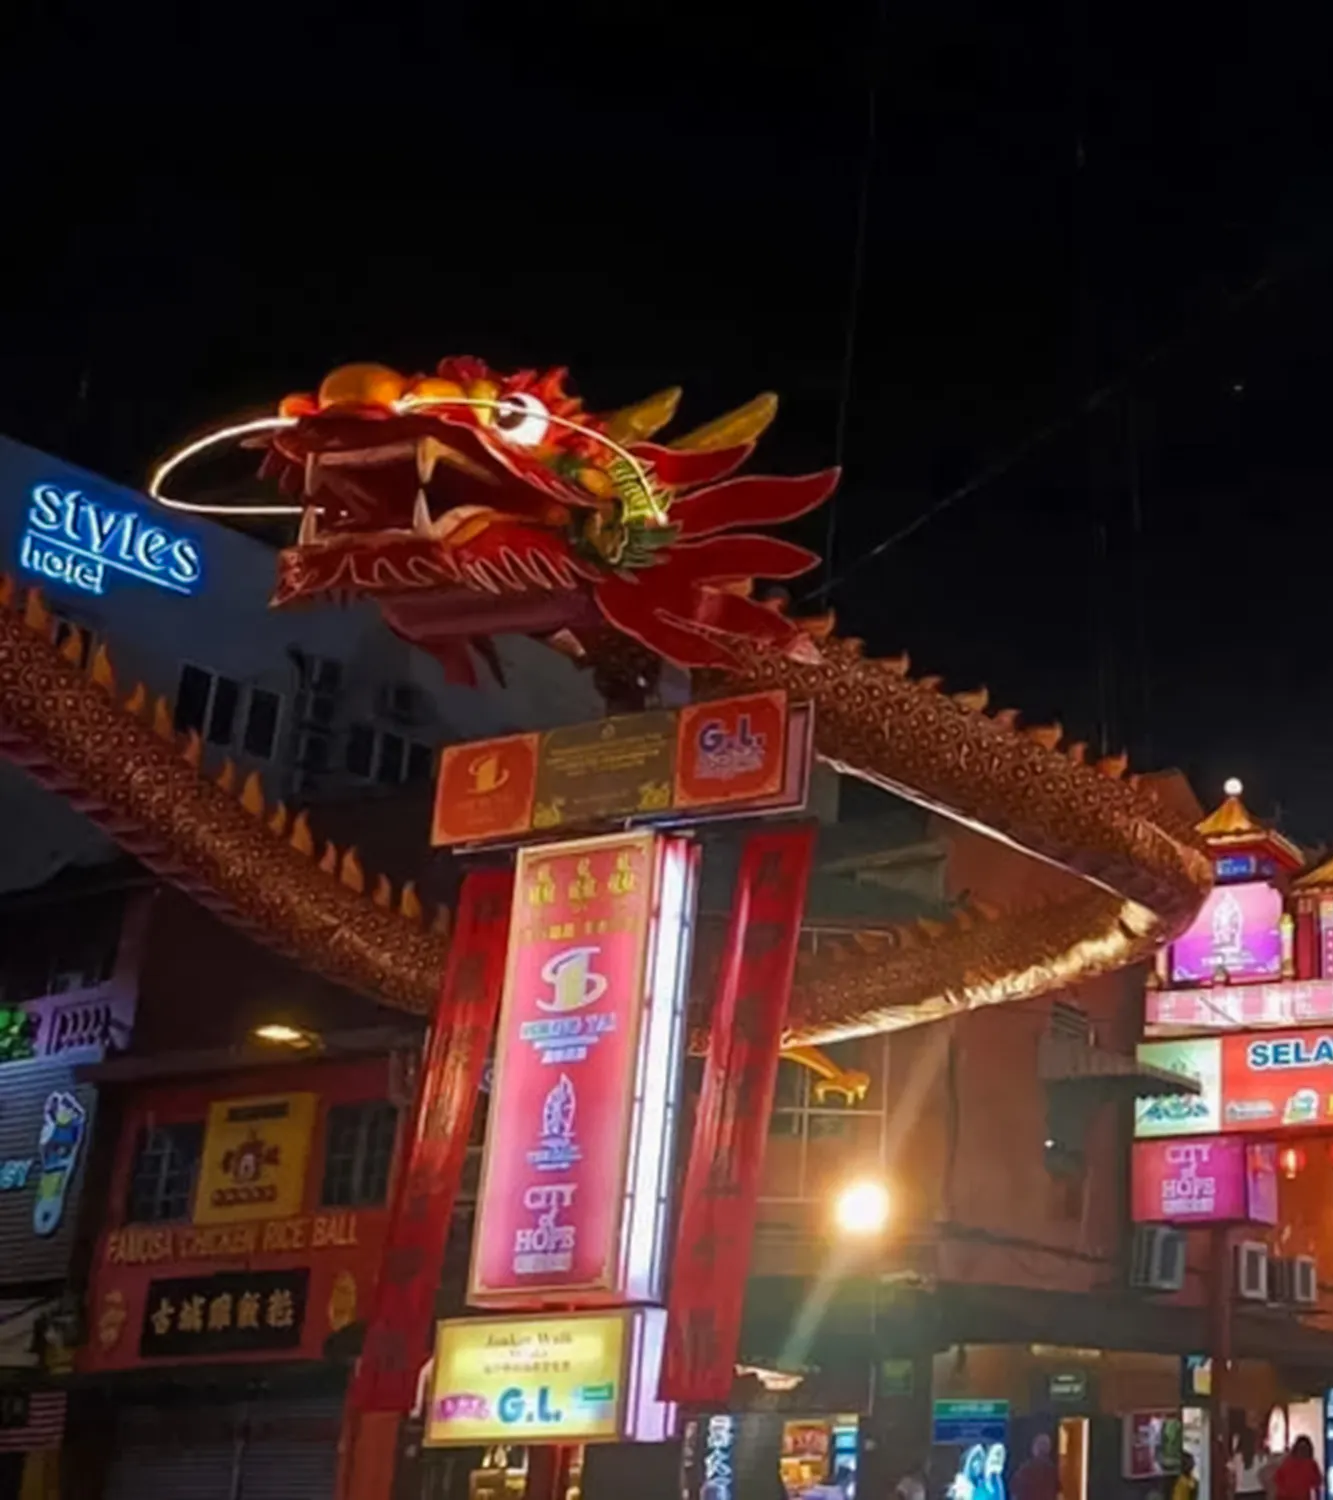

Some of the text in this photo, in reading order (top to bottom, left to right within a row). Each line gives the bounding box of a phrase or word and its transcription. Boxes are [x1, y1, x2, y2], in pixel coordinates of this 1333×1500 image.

[20, 535, 105, 595] hotel
[262, 1218, 308, 1252] RICE
[312, 1212, 358, 1248] BALL
[497, 1386, 562, 1424] G.L.
